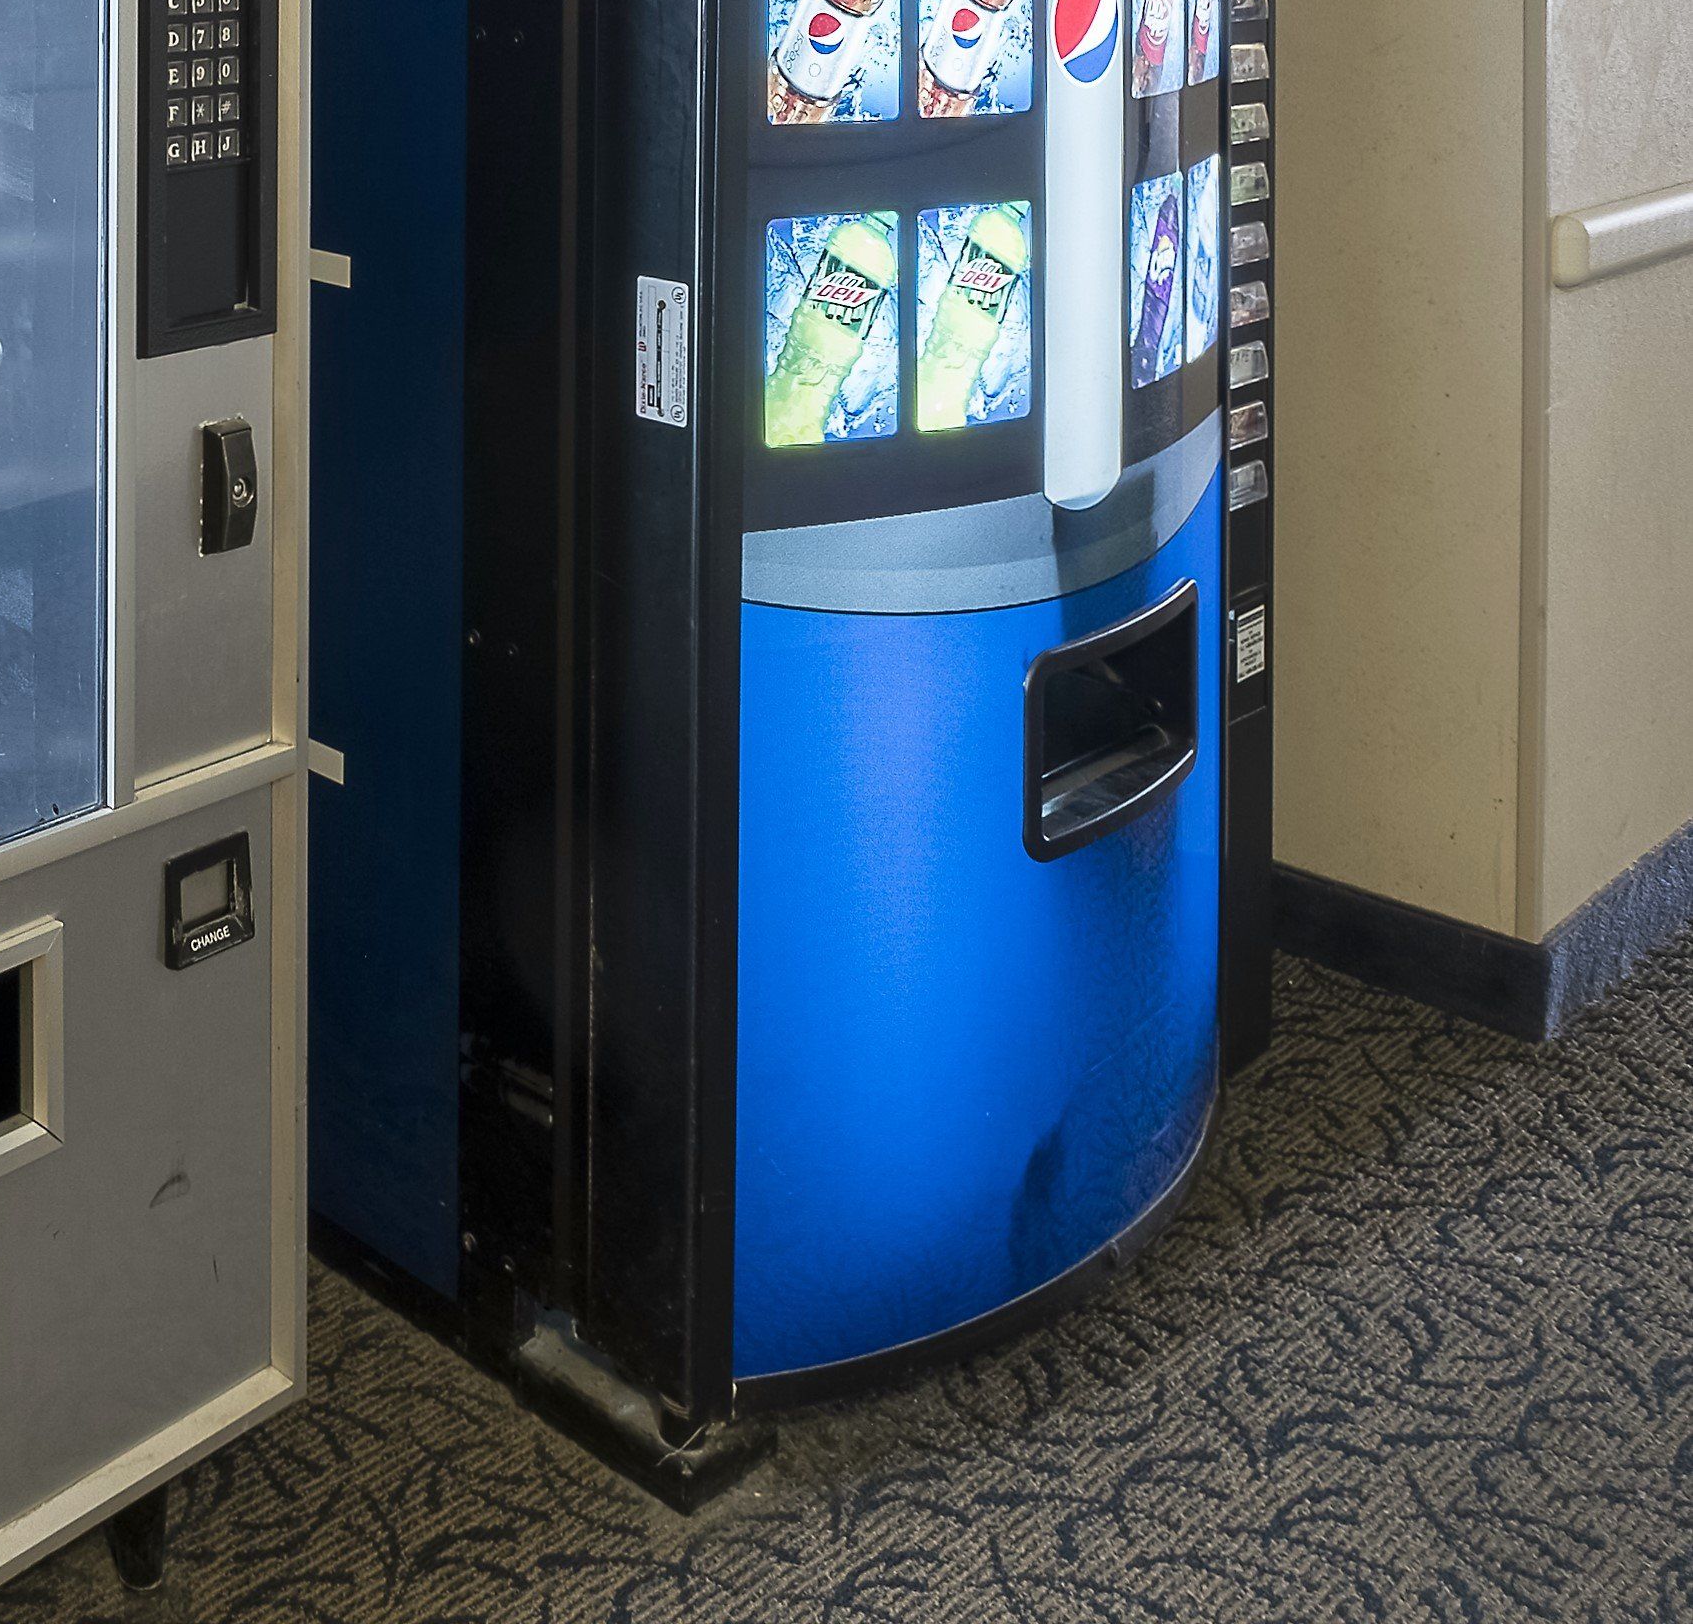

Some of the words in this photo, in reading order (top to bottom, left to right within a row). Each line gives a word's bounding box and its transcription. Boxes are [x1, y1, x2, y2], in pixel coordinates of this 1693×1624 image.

[168, 31, 180, 47] D
[196, 29, 205, 44] 7
[222, 27, 231, 42] 8
[168, 68, 180, 85] E
[196, 66, 206, 81] 9
[222, 63, 231, 79] 0
[168, 105, 179, 122] F
[168, 142, 180, 158] G
[194, 139, 206, 155] H
[222, 136, 231, 152] J
[190, 925, 231, 952] CHANGE
